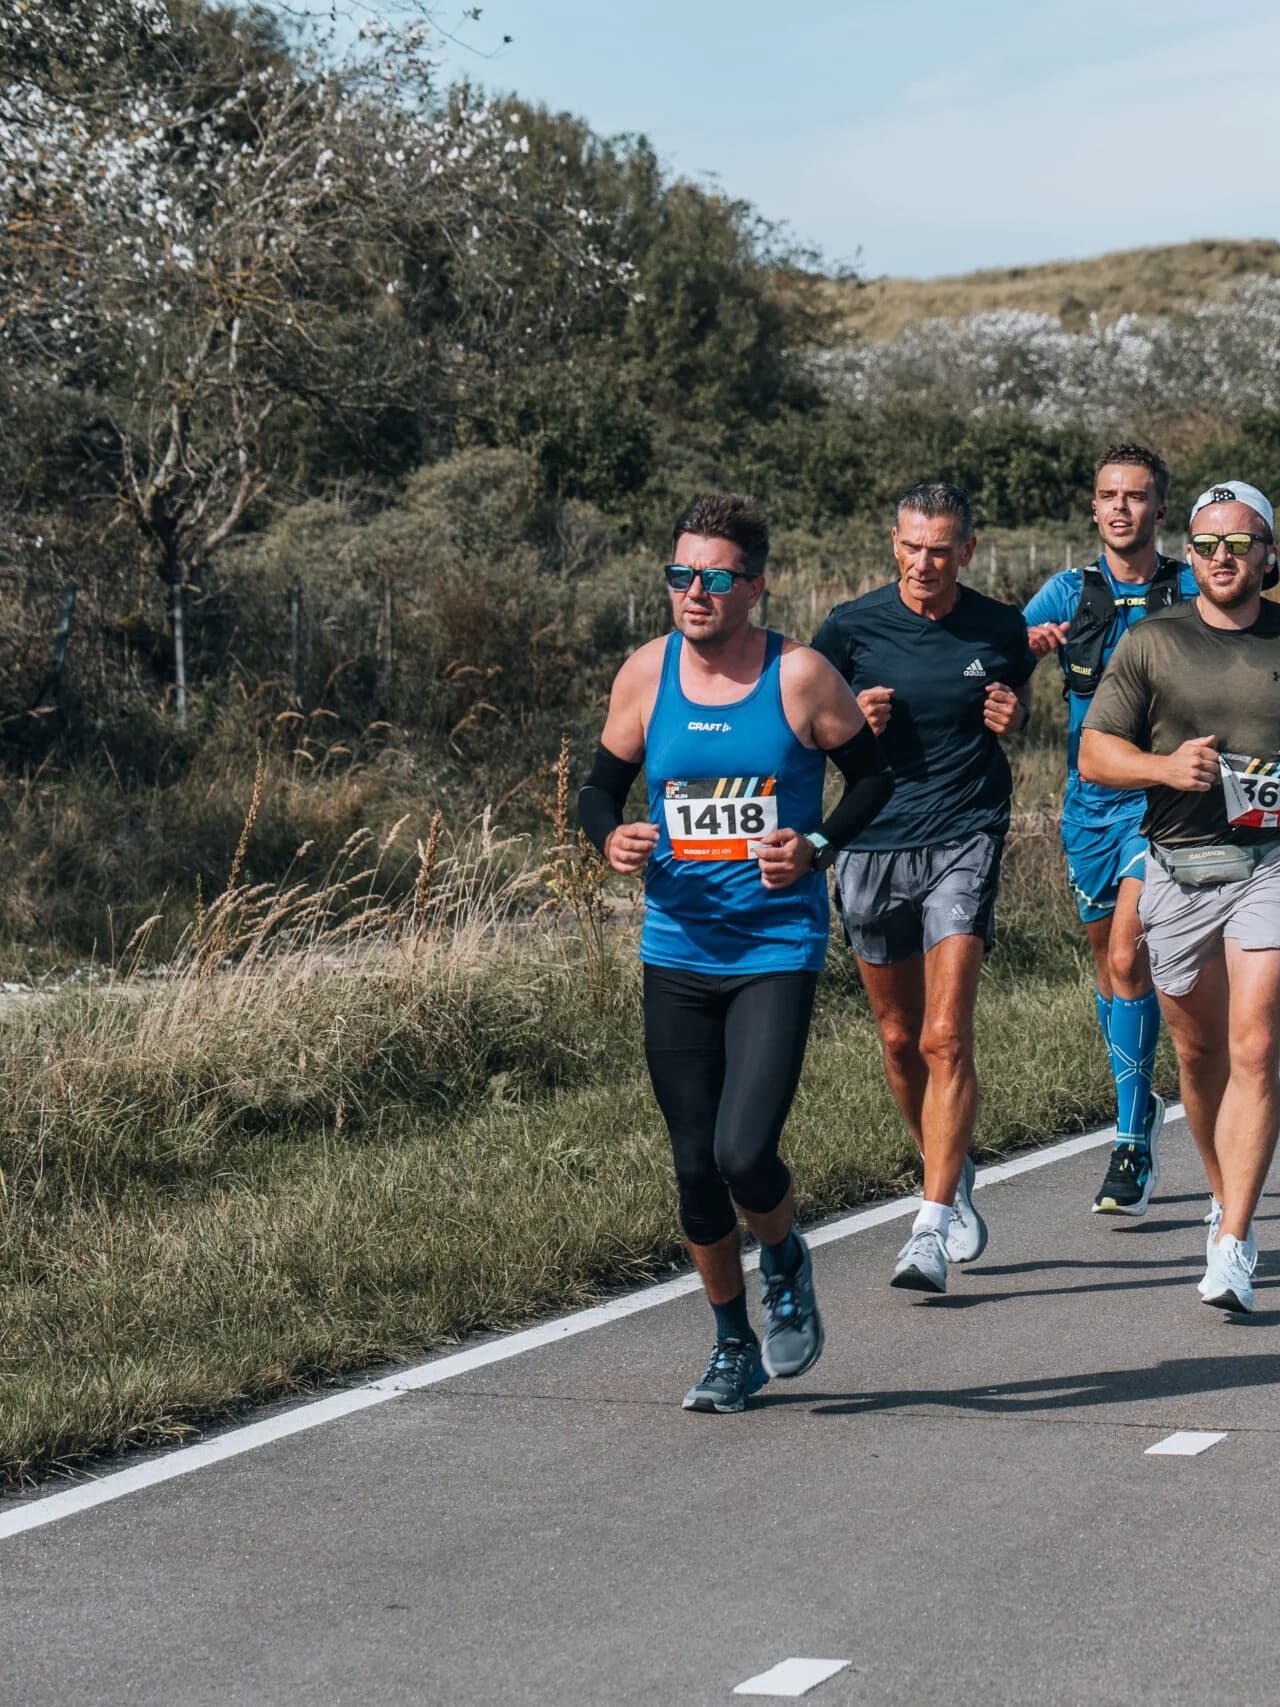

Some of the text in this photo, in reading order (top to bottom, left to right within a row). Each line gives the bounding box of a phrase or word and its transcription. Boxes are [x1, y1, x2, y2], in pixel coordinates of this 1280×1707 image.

[688, 721, 722, 731] CRAFT
[1240, 778, 1280, 808] 36
[676, 803, 765, 835] 1418
[1188, 849, 1226, 860] SALOMON
